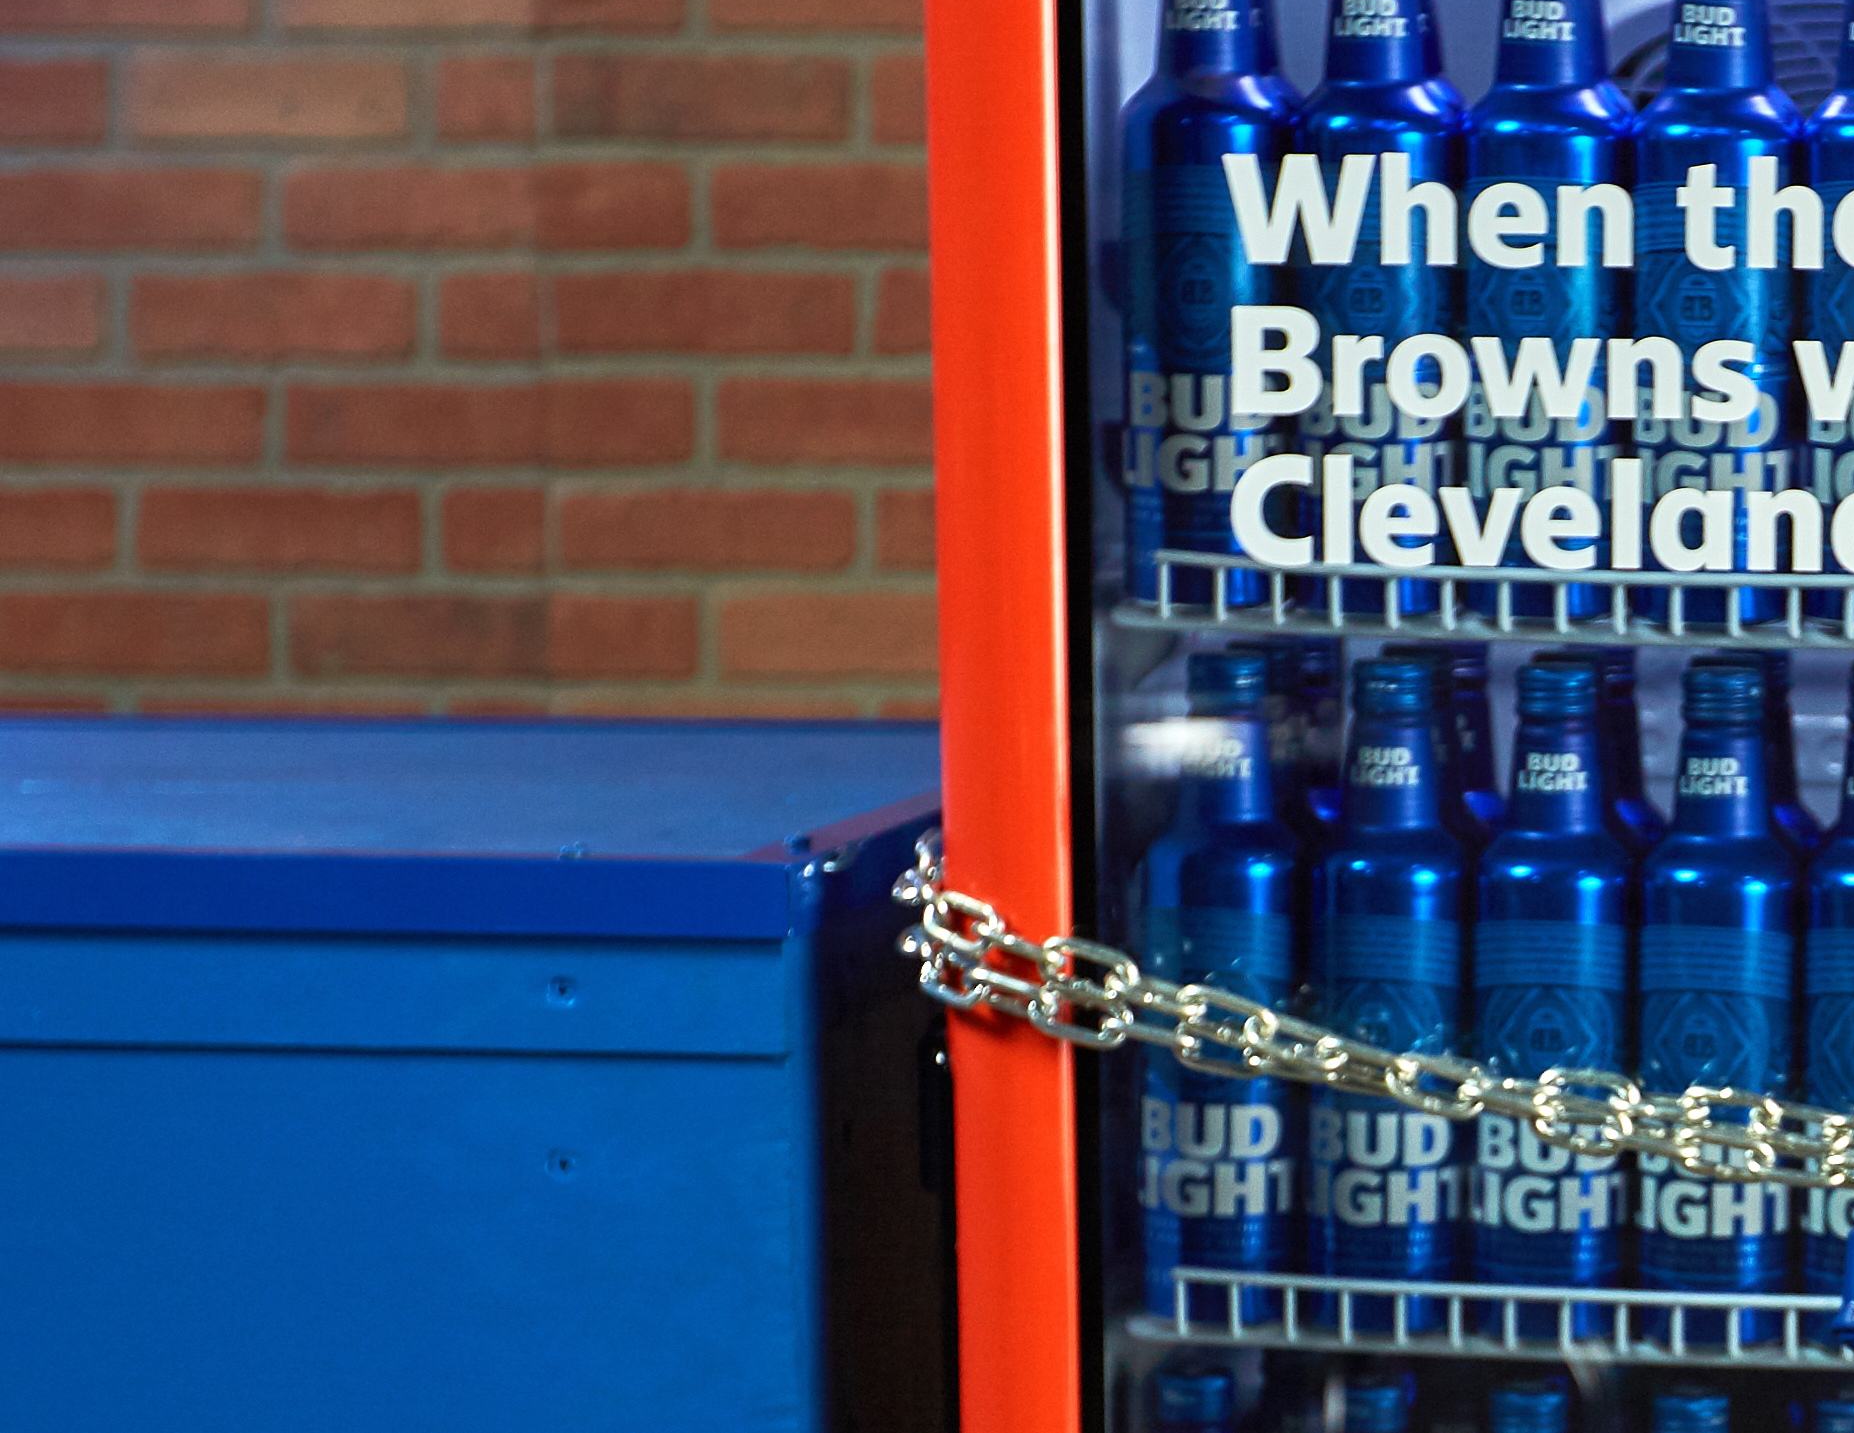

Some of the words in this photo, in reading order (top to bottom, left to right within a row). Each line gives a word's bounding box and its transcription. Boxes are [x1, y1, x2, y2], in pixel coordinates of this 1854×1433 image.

[1166, 10, 1240, 31] LIGHT
[1511, 0, 1566, 20] BUD
[1681, 3, 1737, 26] BUD
[1334, 16, 1409, 38] LIGHT
[1503, 19, 1577, 42] LIGHT
[1673, 23, 1748, 47] LIGHT
[1221, 152, 1635, 268] When
[1230, 305, 1760, 423] Browns
[1466, 442, 1624, 503] IGHT
[1358, 746, 1412, 766] BUD
[1527, 752, 1580, 771] BUD
[1687, 757, 1740, 776] BUD
[1351, 765, 1421, 786] LIGHT
[1518, 771, 1588, 791] LIGHT
[1679, 775, 1749, 796] LIGHT
[1141, 1095, 1281, 1160] BUD
[1310, 1105, 1450, 1168] BUD
